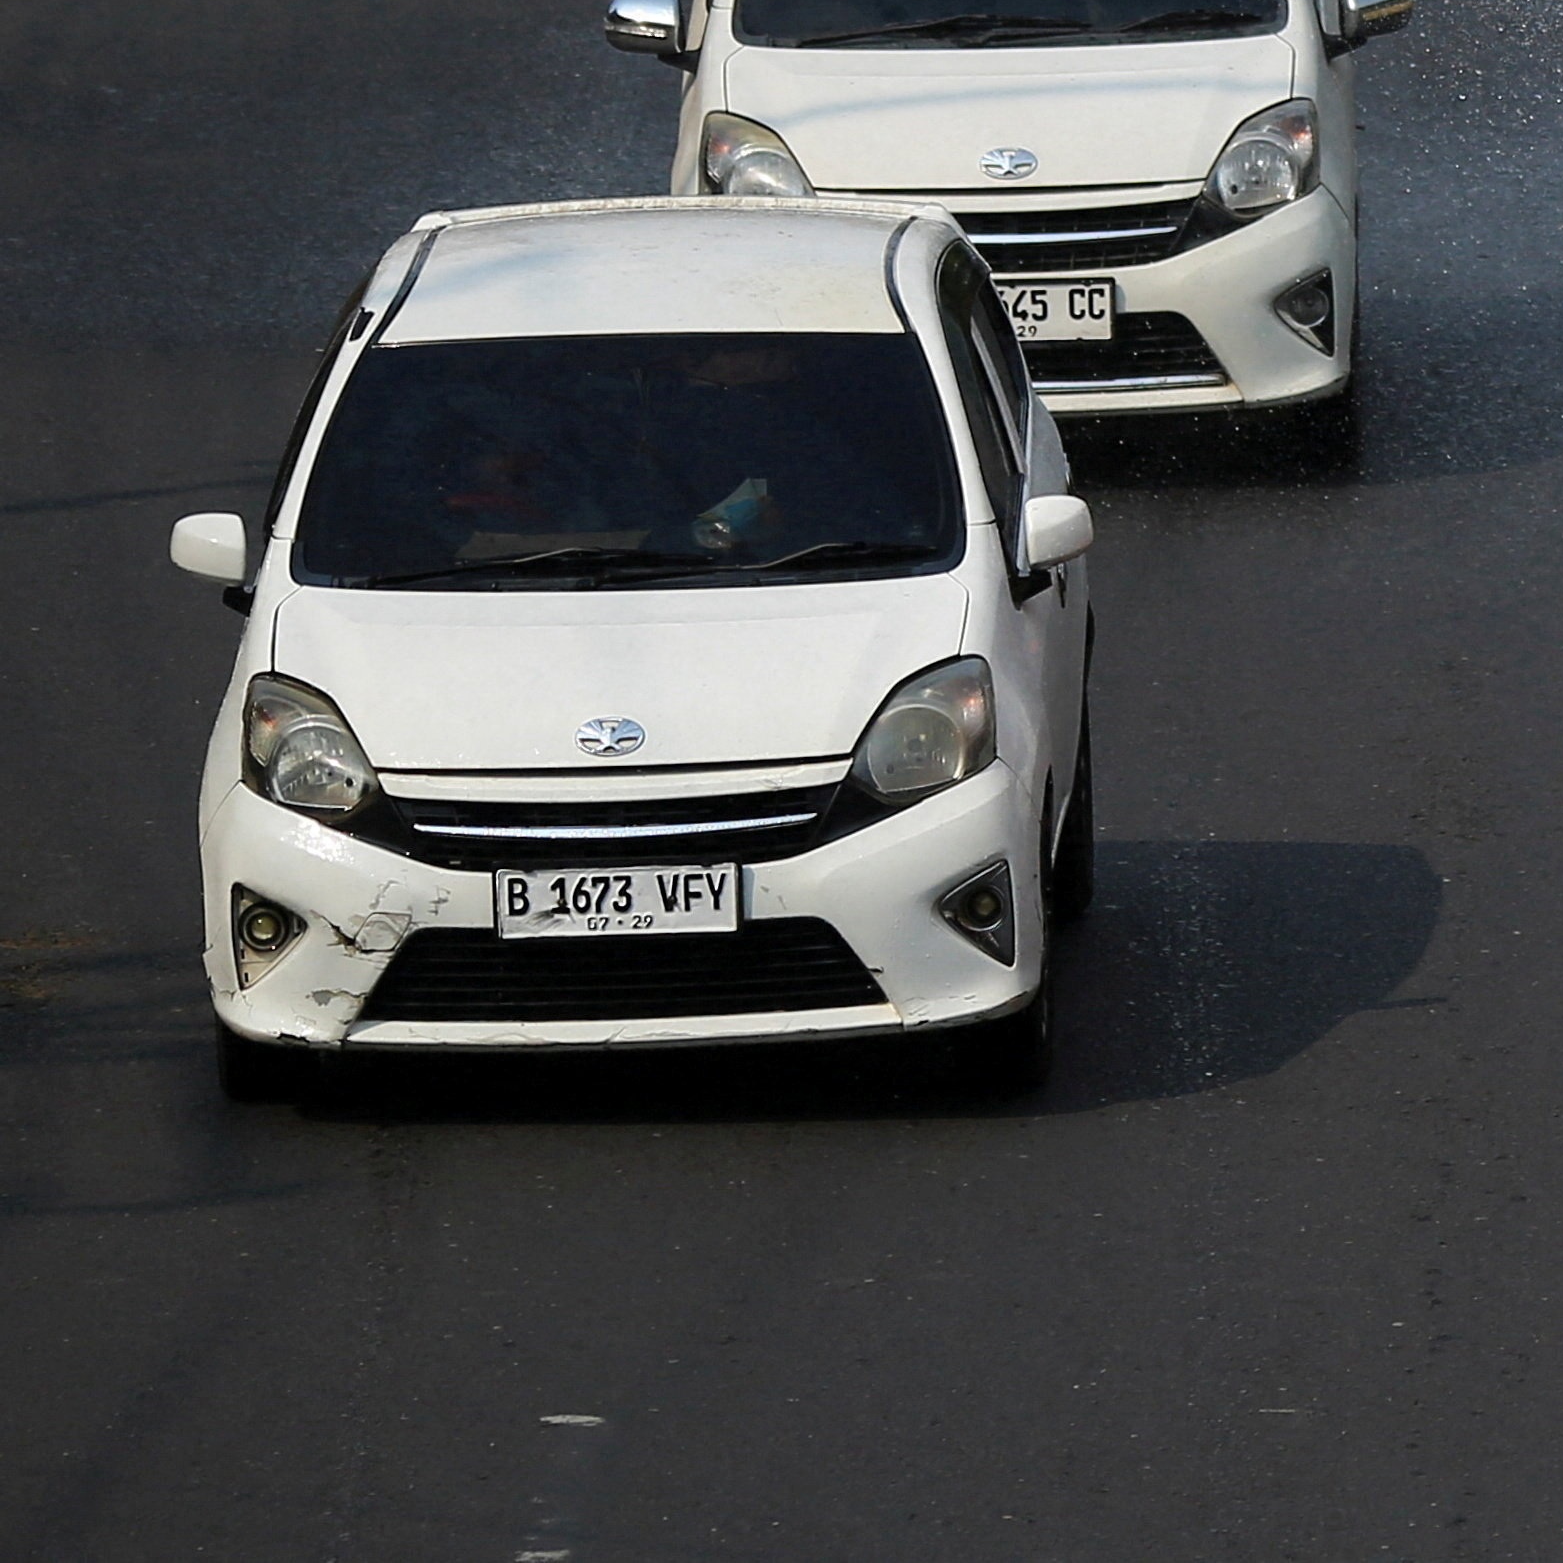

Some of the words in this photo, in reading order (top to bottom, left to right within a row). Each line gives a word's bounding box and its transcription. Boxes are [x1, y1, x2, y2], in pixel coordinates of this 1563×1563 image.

[1069, 288, 1105, 320] CC
[507, 877, 530, 917] B
[549, 875, 633, 915] 1673
[656, 872, 728, 912] VFY
